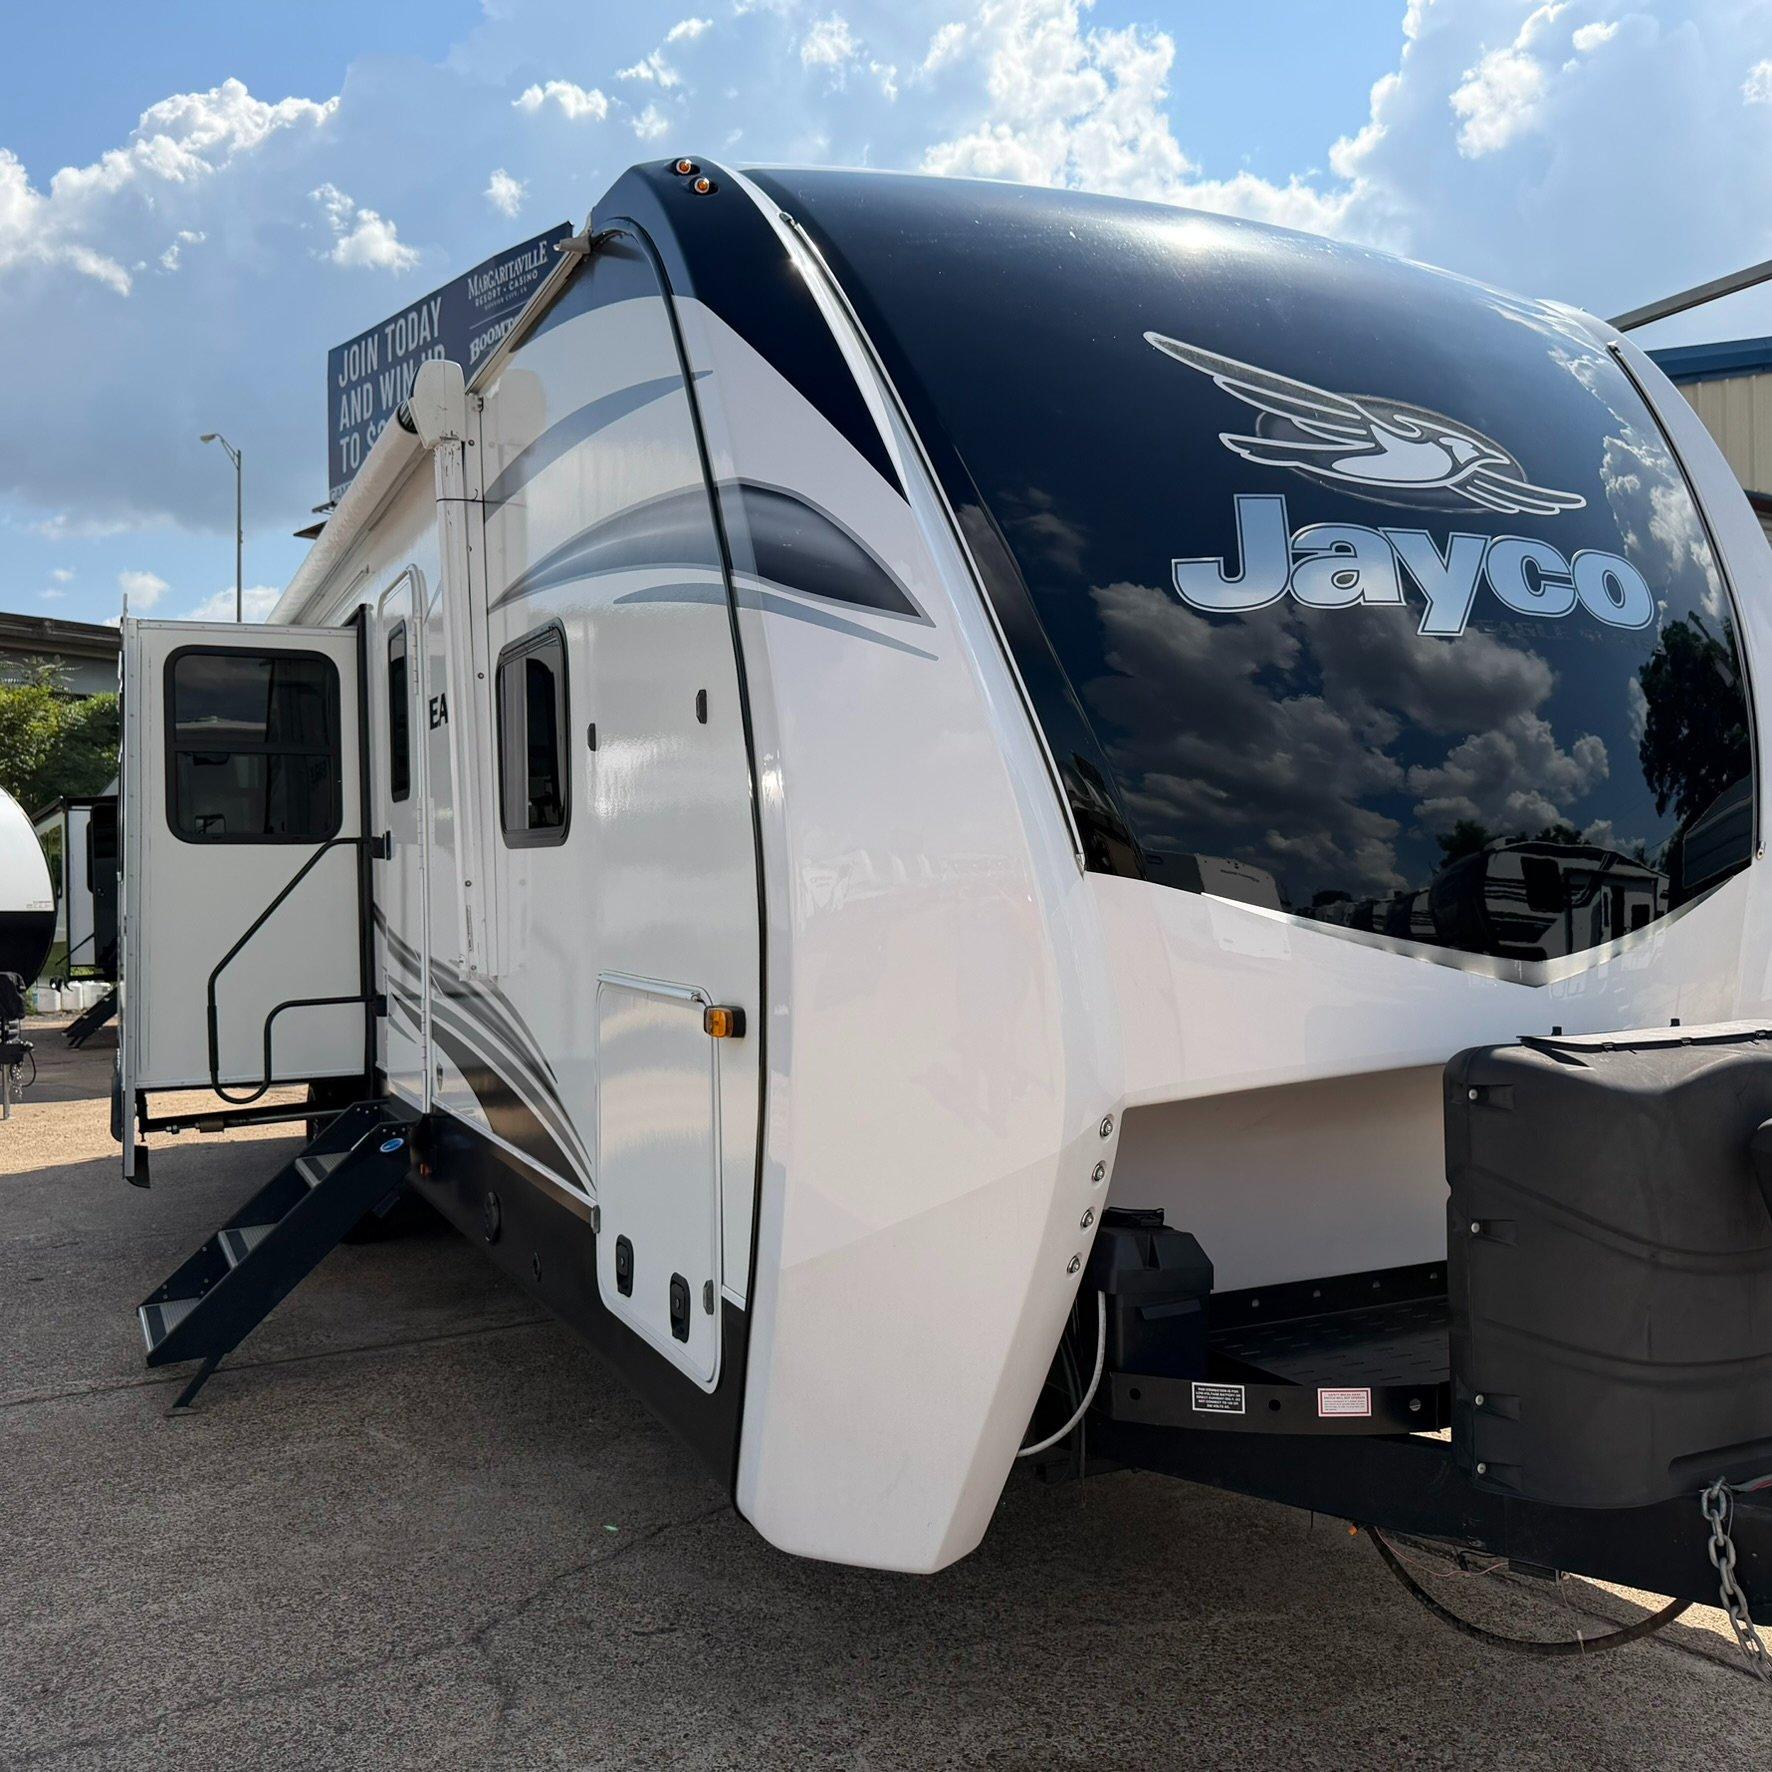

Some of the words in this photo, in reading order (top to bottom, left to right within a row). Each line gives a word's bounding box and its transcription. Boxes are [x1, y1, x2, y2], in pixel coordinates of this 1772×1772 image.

[467, 240, 548, 300] MARGARITAVILLE
[475, 287, 502, 307] RESORT
[508, 269, 539, 291] CASINO
[338, 333, 379, 388] JOIN
[384, 296, 442, 363] TODAY
[339, 382, 373, 432] AND
[379, 359, 415, 411] WIN
[339, 434, 360, 474] TO
[1171, 493, 1655, 637] Jayco
[429, 692, 449, 730] EA
